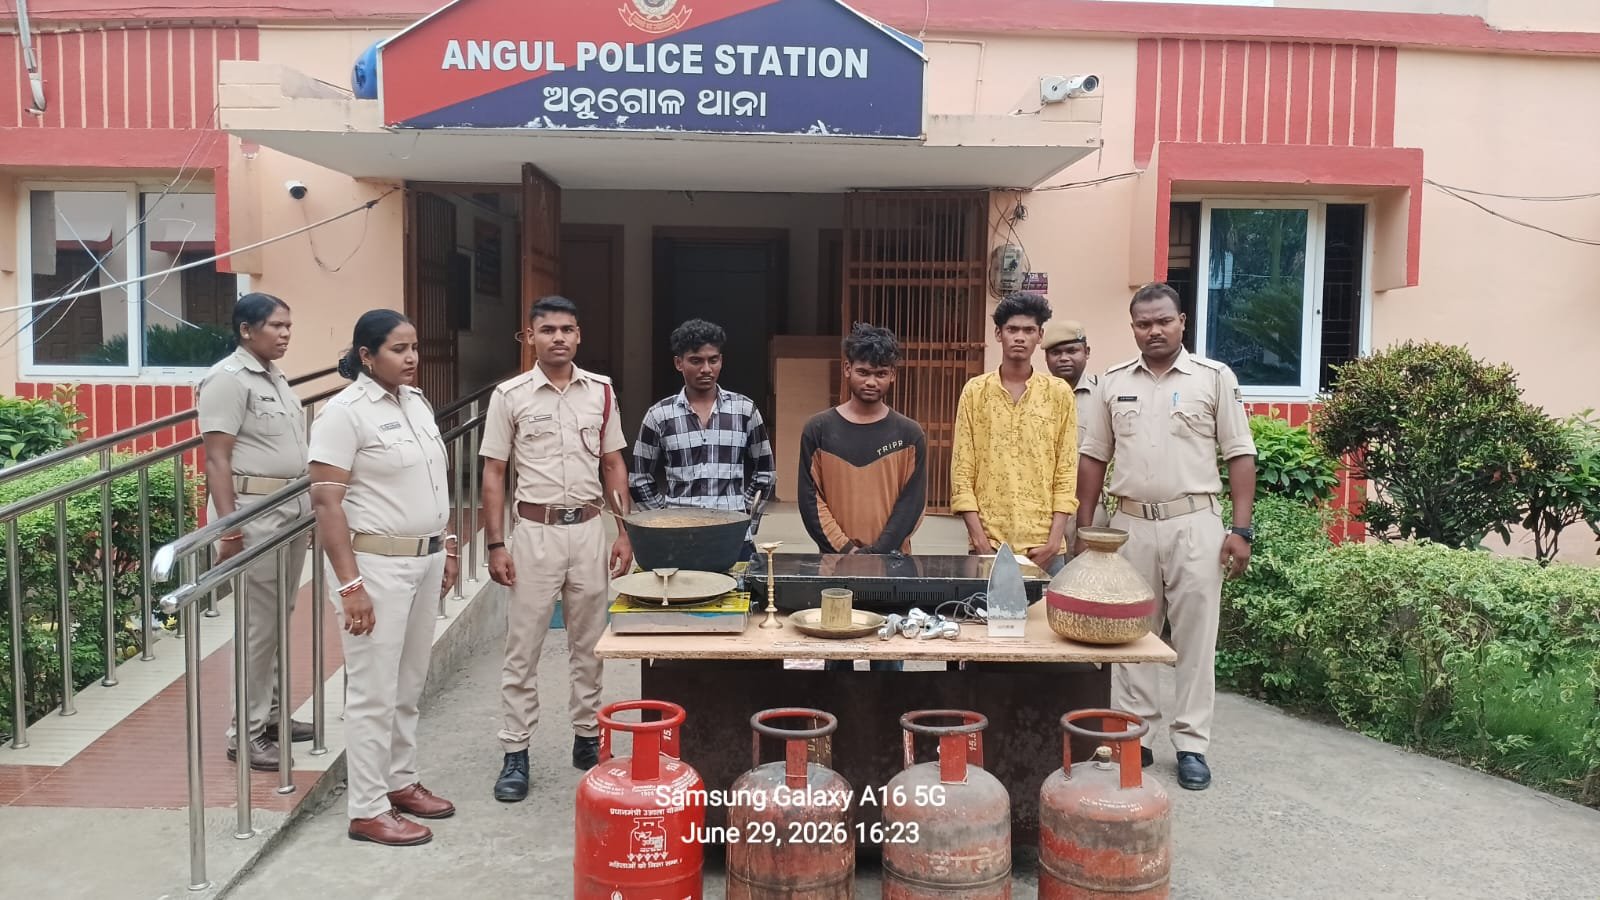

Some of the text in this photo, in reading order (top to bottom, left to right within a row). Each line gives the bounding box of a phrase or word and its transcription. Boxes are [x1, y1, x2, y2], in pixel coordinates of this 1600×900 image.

[441, 39, 868, 79] ANGUL POLICE STATION
[543, 86, 767, 120] ଅନୁଗୋଳ ଥାନା
[876, 439, 904, 456] TRIPP
